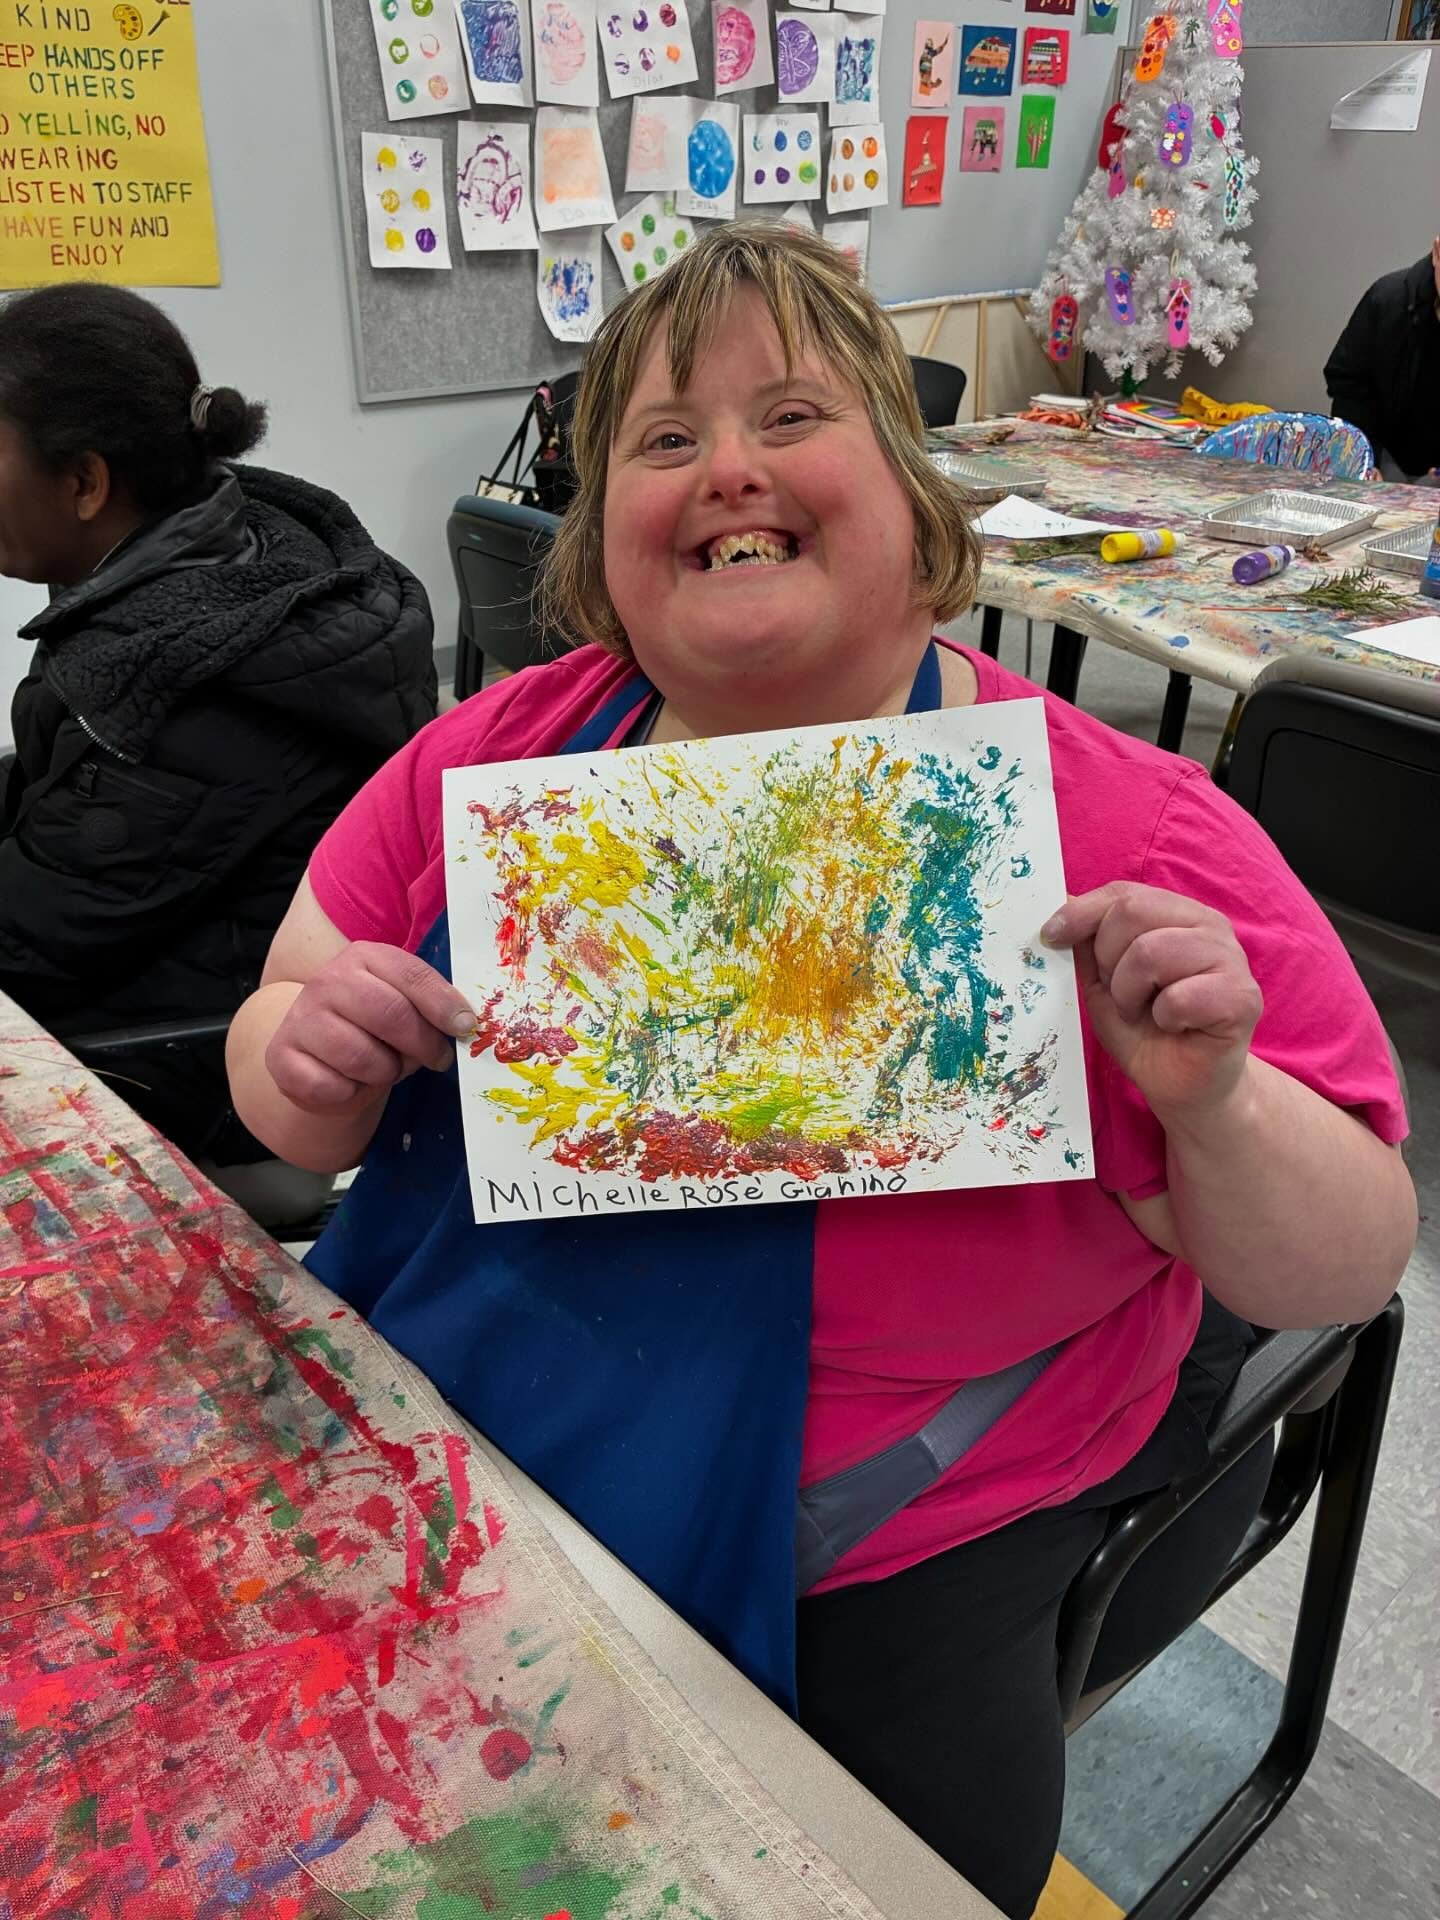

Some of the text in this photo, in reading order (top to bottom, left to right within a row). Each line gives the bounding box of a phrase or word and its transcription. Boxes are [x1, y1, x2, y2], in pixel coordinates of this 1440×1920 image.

[16, 1, 90, 31] KIND
[29, 72, 135, 100] OTHERS
[136, 114, 166, 137] NO
[5, 216, 169, 239] HAVE FUN AND
[50, 244, 124, 266] ENJOY
